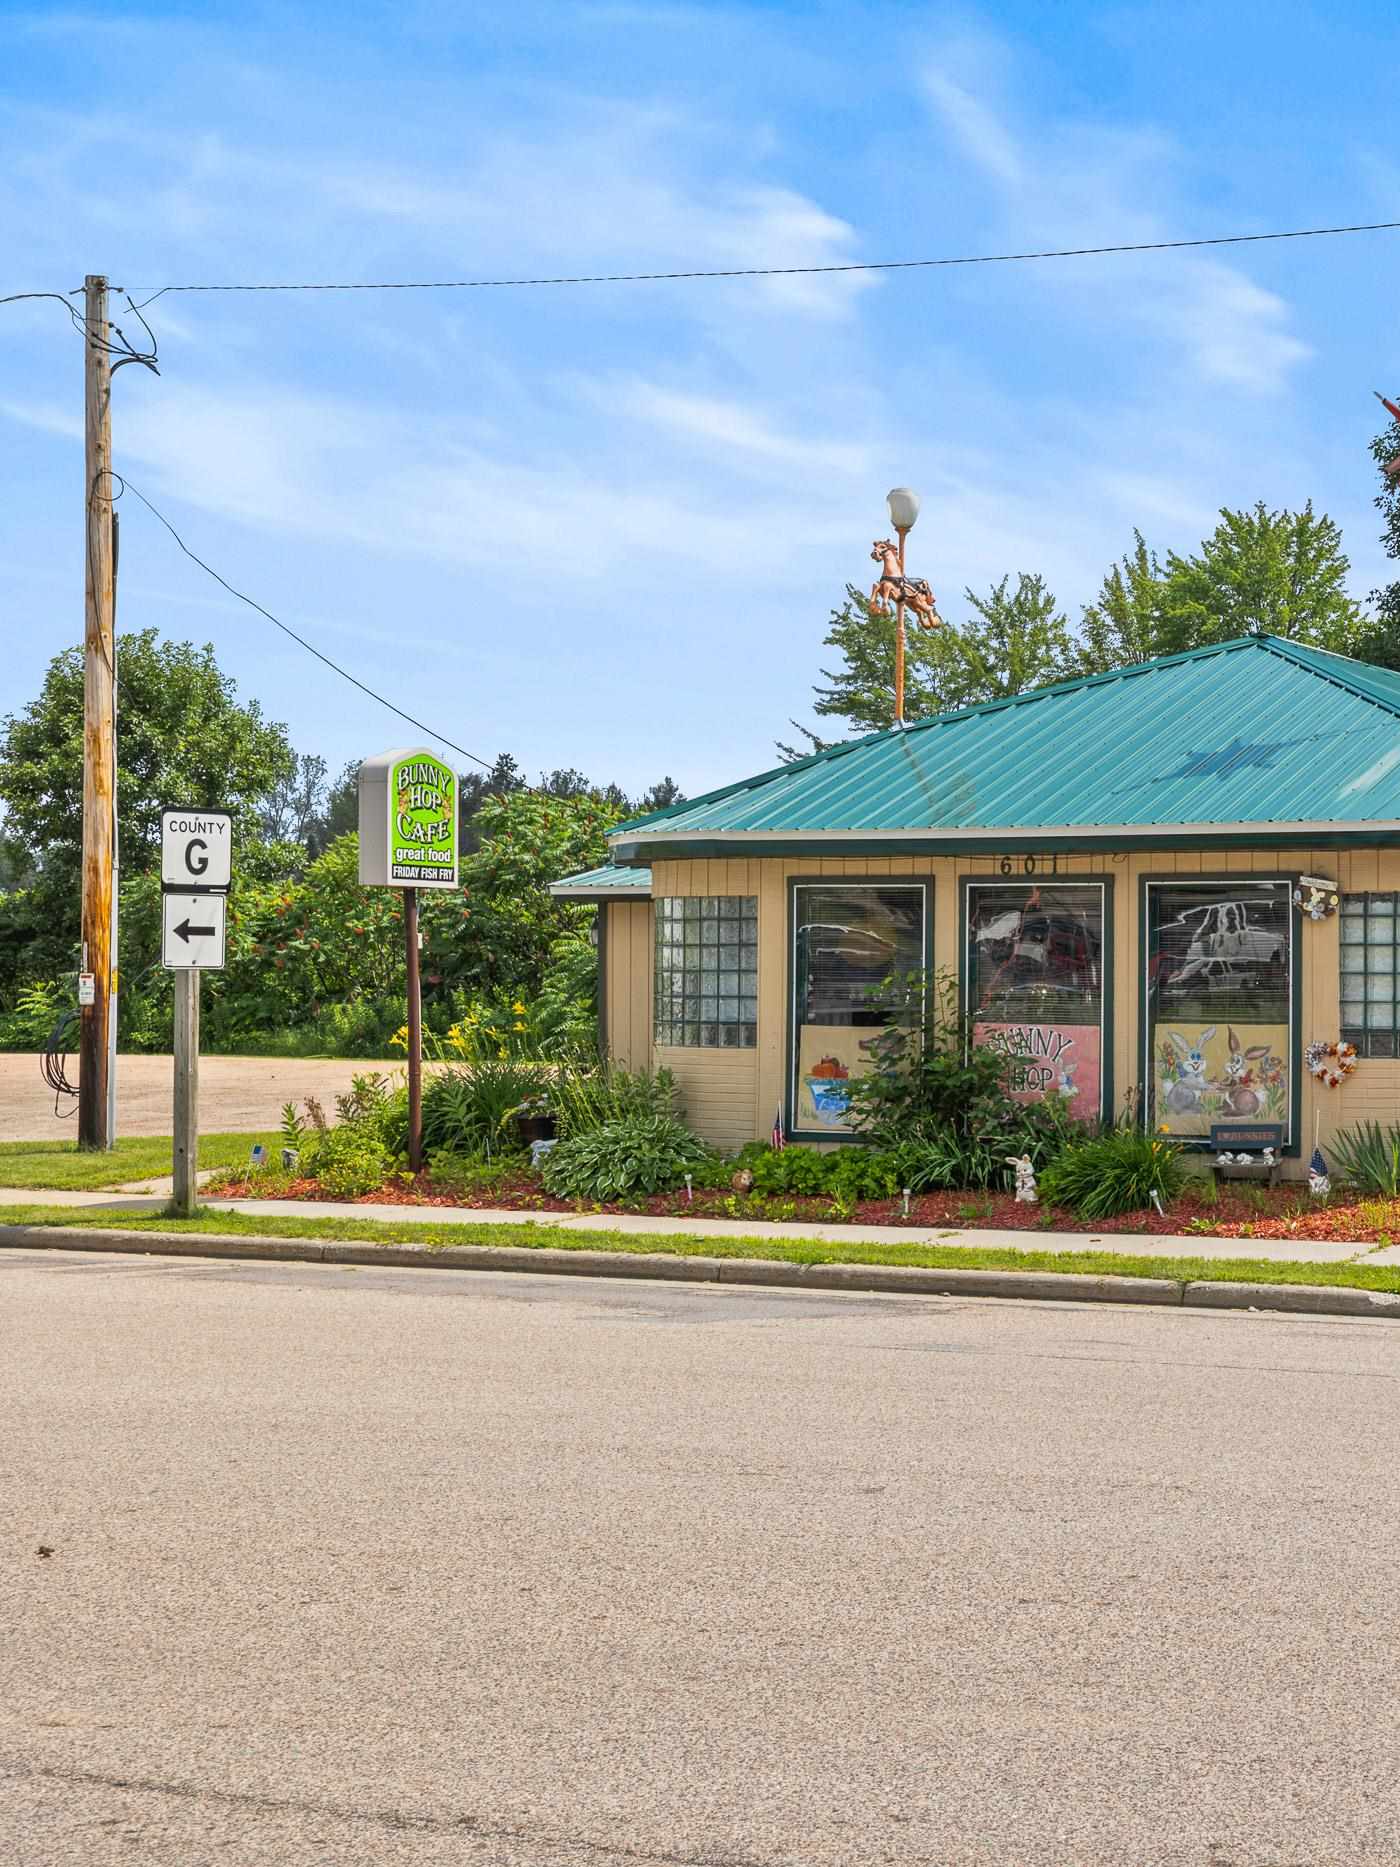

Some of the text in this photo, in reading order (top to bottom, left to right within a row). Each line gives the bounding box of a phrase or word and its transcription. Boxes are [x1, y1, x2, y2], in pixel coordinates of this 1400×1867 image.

[398, 763, 451, 793] BUNNY
[409, 786, 443, 811] HOP
[169, 820, 225, 834] COUNTY
[397, 813, 451, 843] CAFE
[185, 838, 209, 876] G
[396, 848, 451, 863] great food
[1000, 855, 1057, 875] 601
[392, 866, 455, 880] FRIDAY FISH FRY
